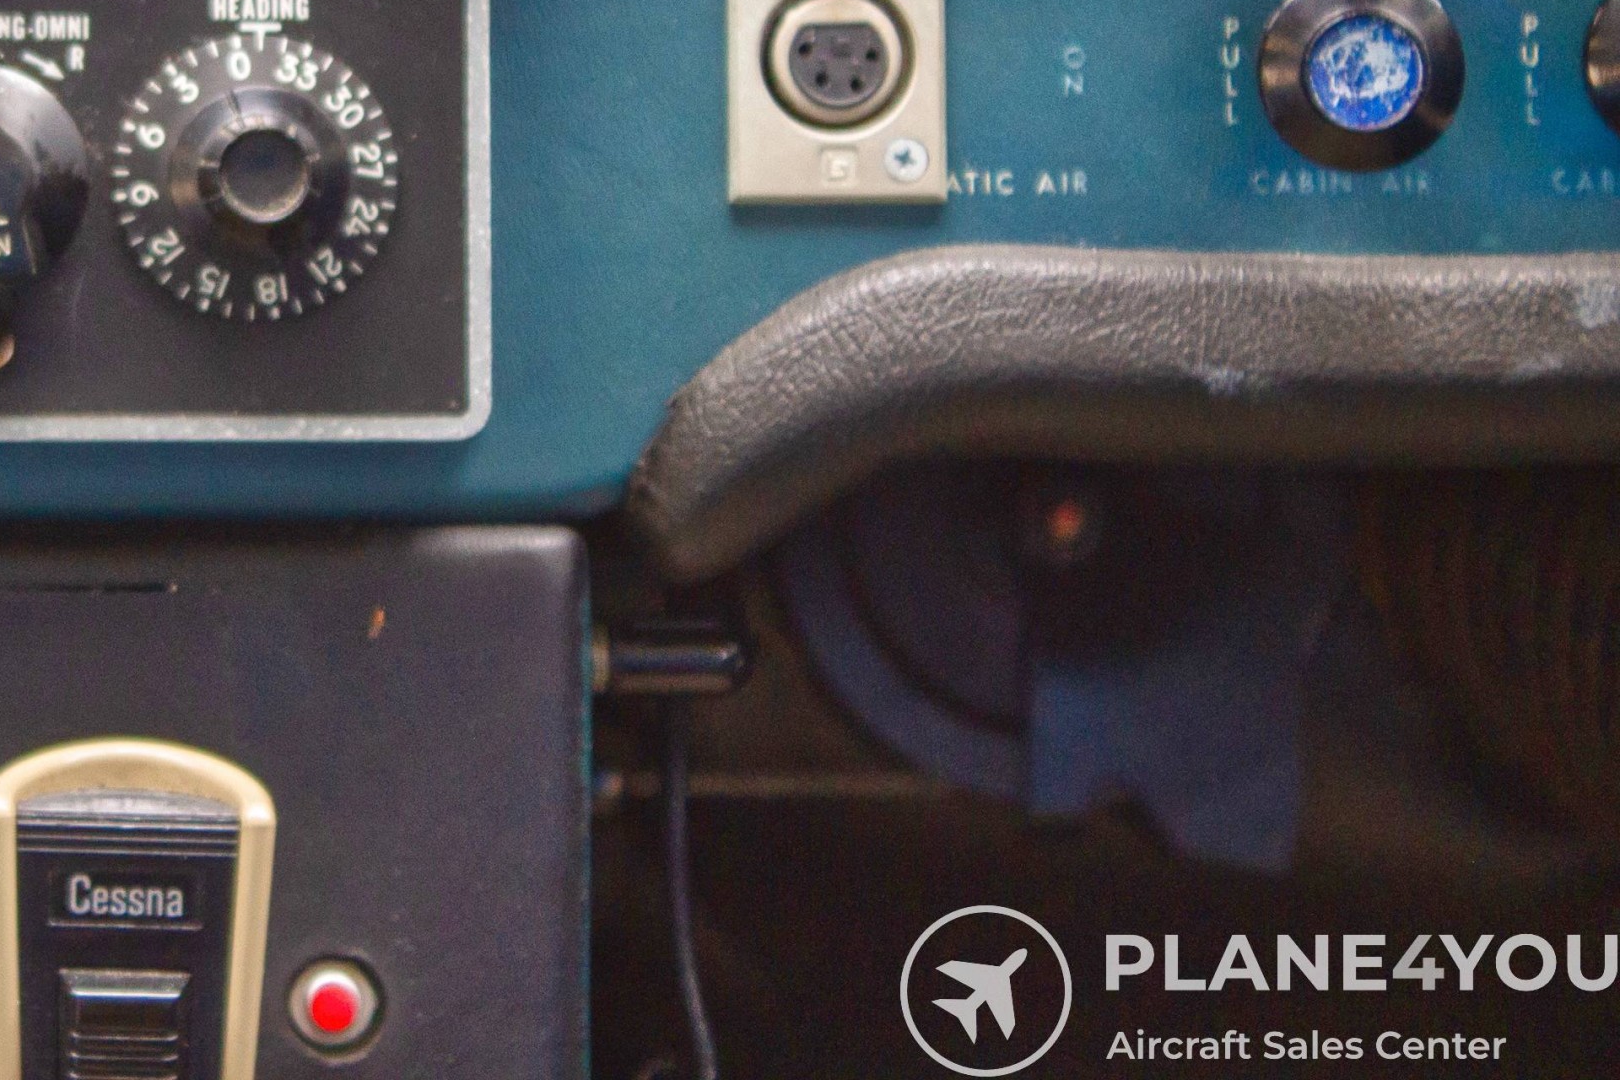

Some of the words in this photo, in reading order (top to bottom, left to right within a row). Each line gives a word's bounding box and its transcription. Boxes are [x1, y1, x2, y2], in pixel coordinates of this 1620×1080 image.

[69, 46, 85, 71] R
[229, 51, 251, 81] 0
[276, 54, 319, 91] 33
[1221, 15, 1241, 128] PULL
[1520, 12, 1540, 127] PULL
[172, 72, 199, 103] 3
[324, 86, 364, 129] 30
[350, 142, 384, 180] 27
[1036, 171, 1088, 196] AIR
[1252, 169, 1354, 197] CABIN
[1382, 171, 1433, 197] AIR
[344, 197, 380, 238] 24
[148, 226, 185, 267] 12
[197, 265, 230, 300] 15
[307, 247, 343, 284] 21
[257, 273, 289, 305] 18
[66, 875, 184, 919] Cessna
